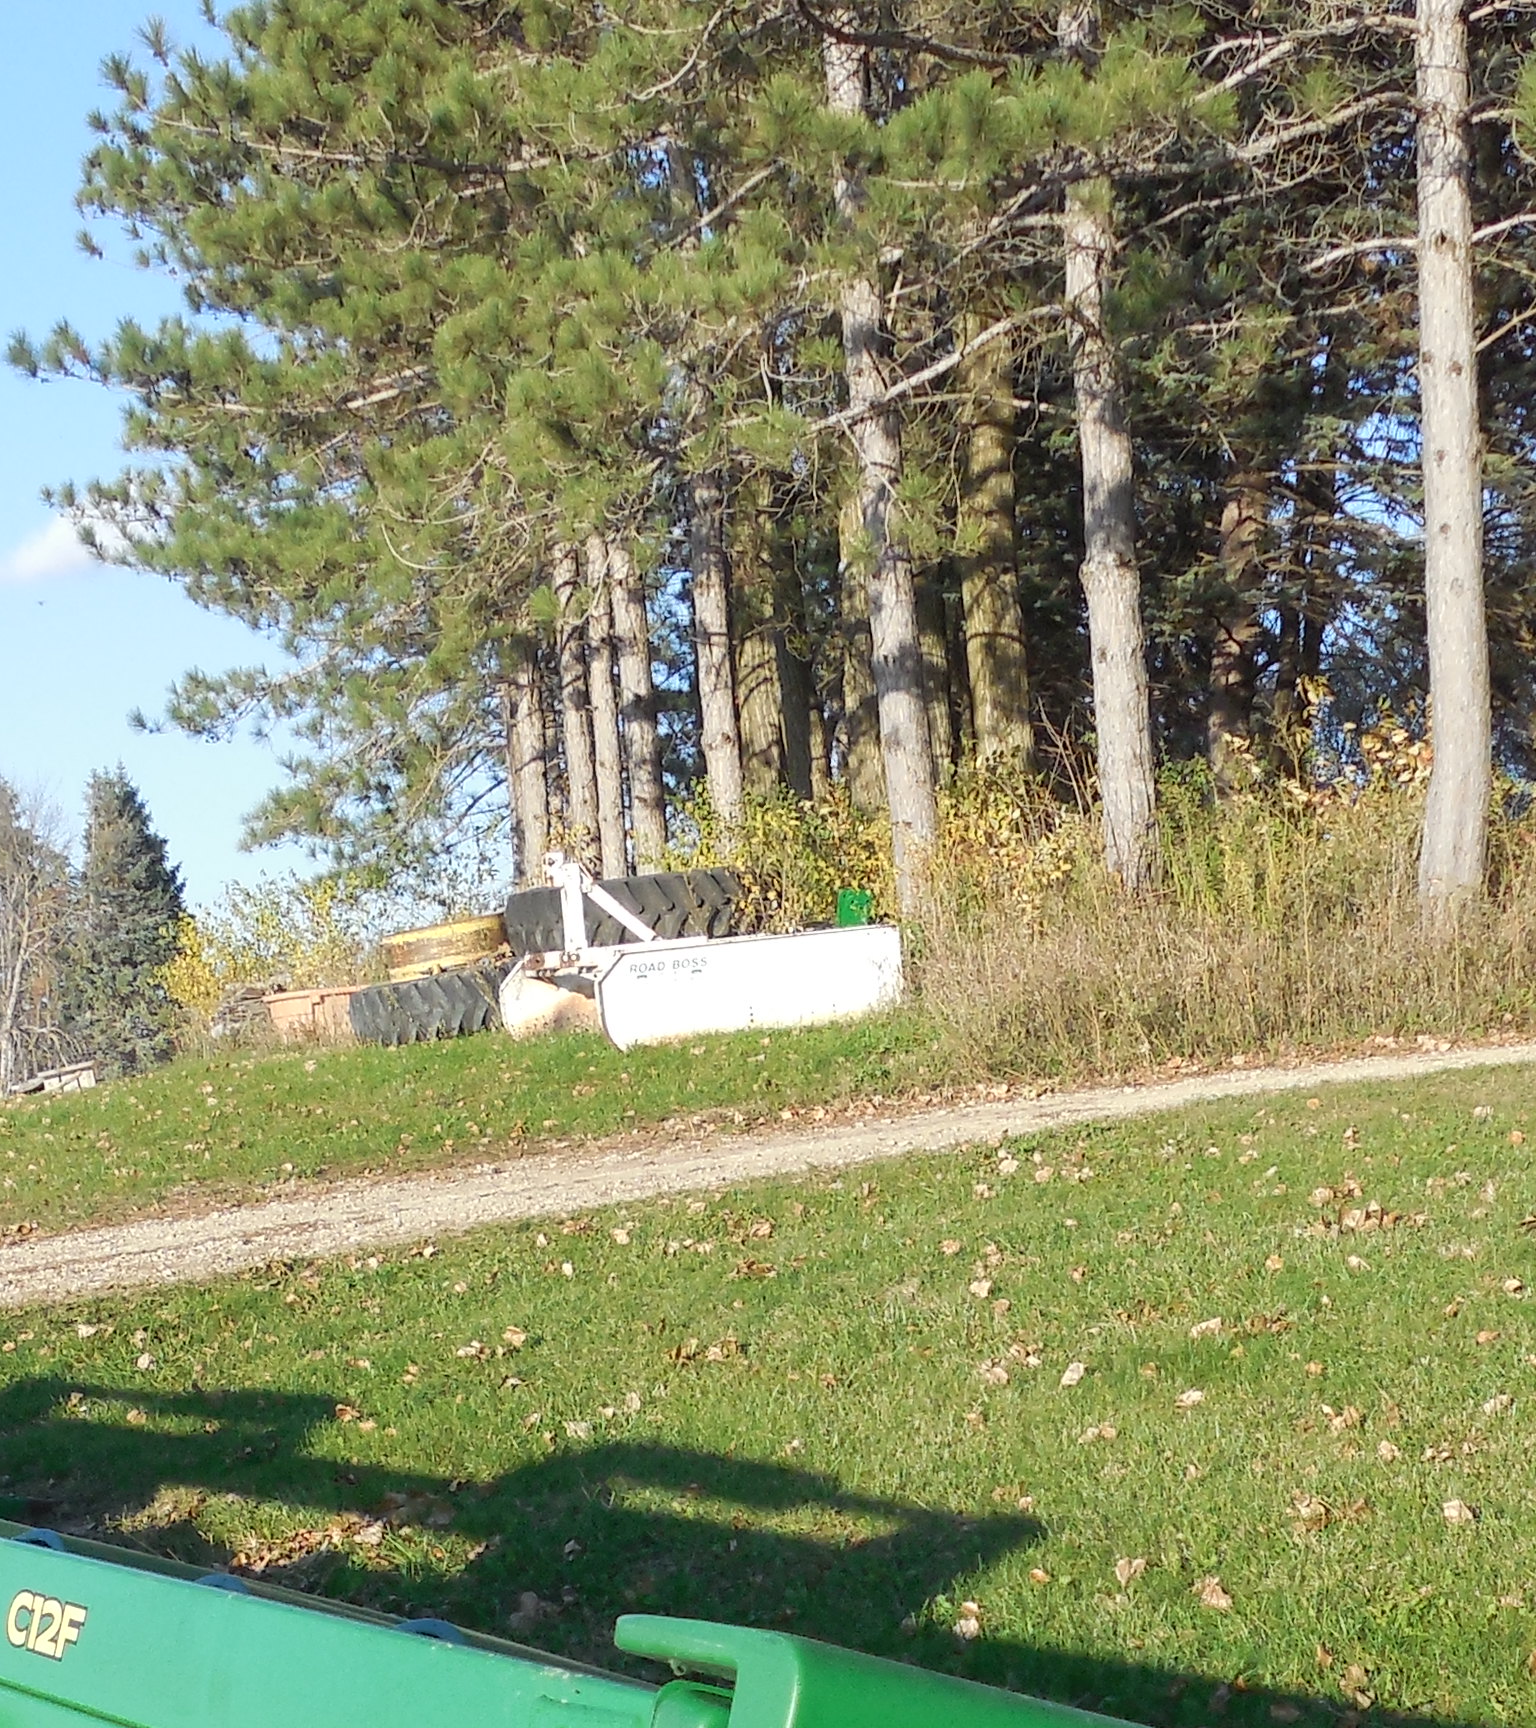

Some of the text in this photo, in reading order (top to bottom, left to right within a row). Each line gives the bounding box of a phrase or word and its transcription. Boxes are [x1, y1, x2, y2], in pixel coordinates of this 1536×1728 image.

[630, 957, 707, 973] ROAD BOSS
[7, 1589, 88, 1662] C12F
